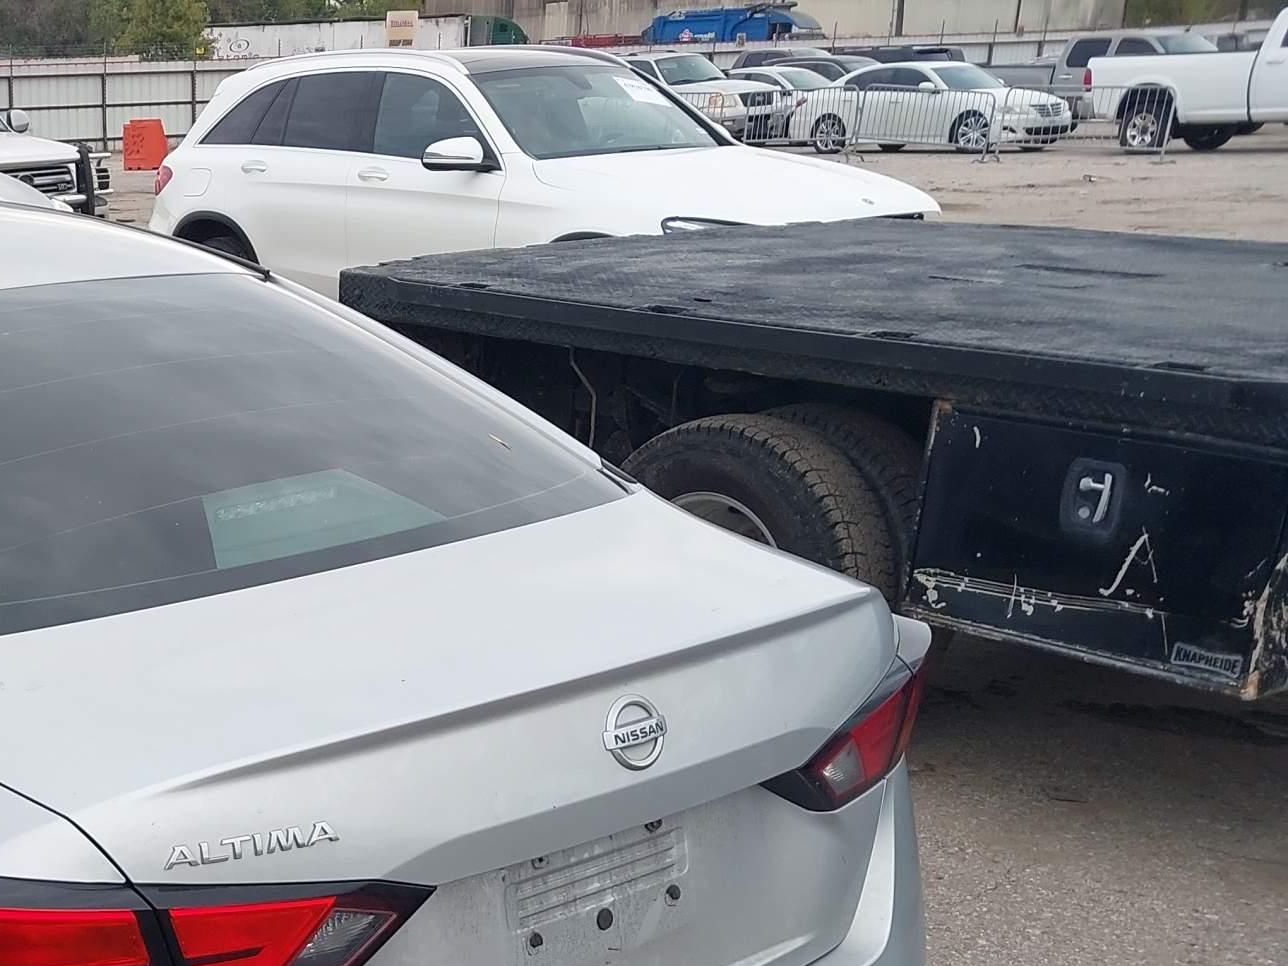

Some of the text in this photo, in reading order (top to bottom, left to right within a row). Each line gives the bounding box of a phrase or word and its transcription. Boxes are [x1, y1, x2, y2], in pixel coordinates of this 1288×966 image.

[1174, 645, 1241, 675] KNAPHEIDE
[614, 721, 664, 745] NISSAN
[164, 820, 340, 870] ALTIMA
